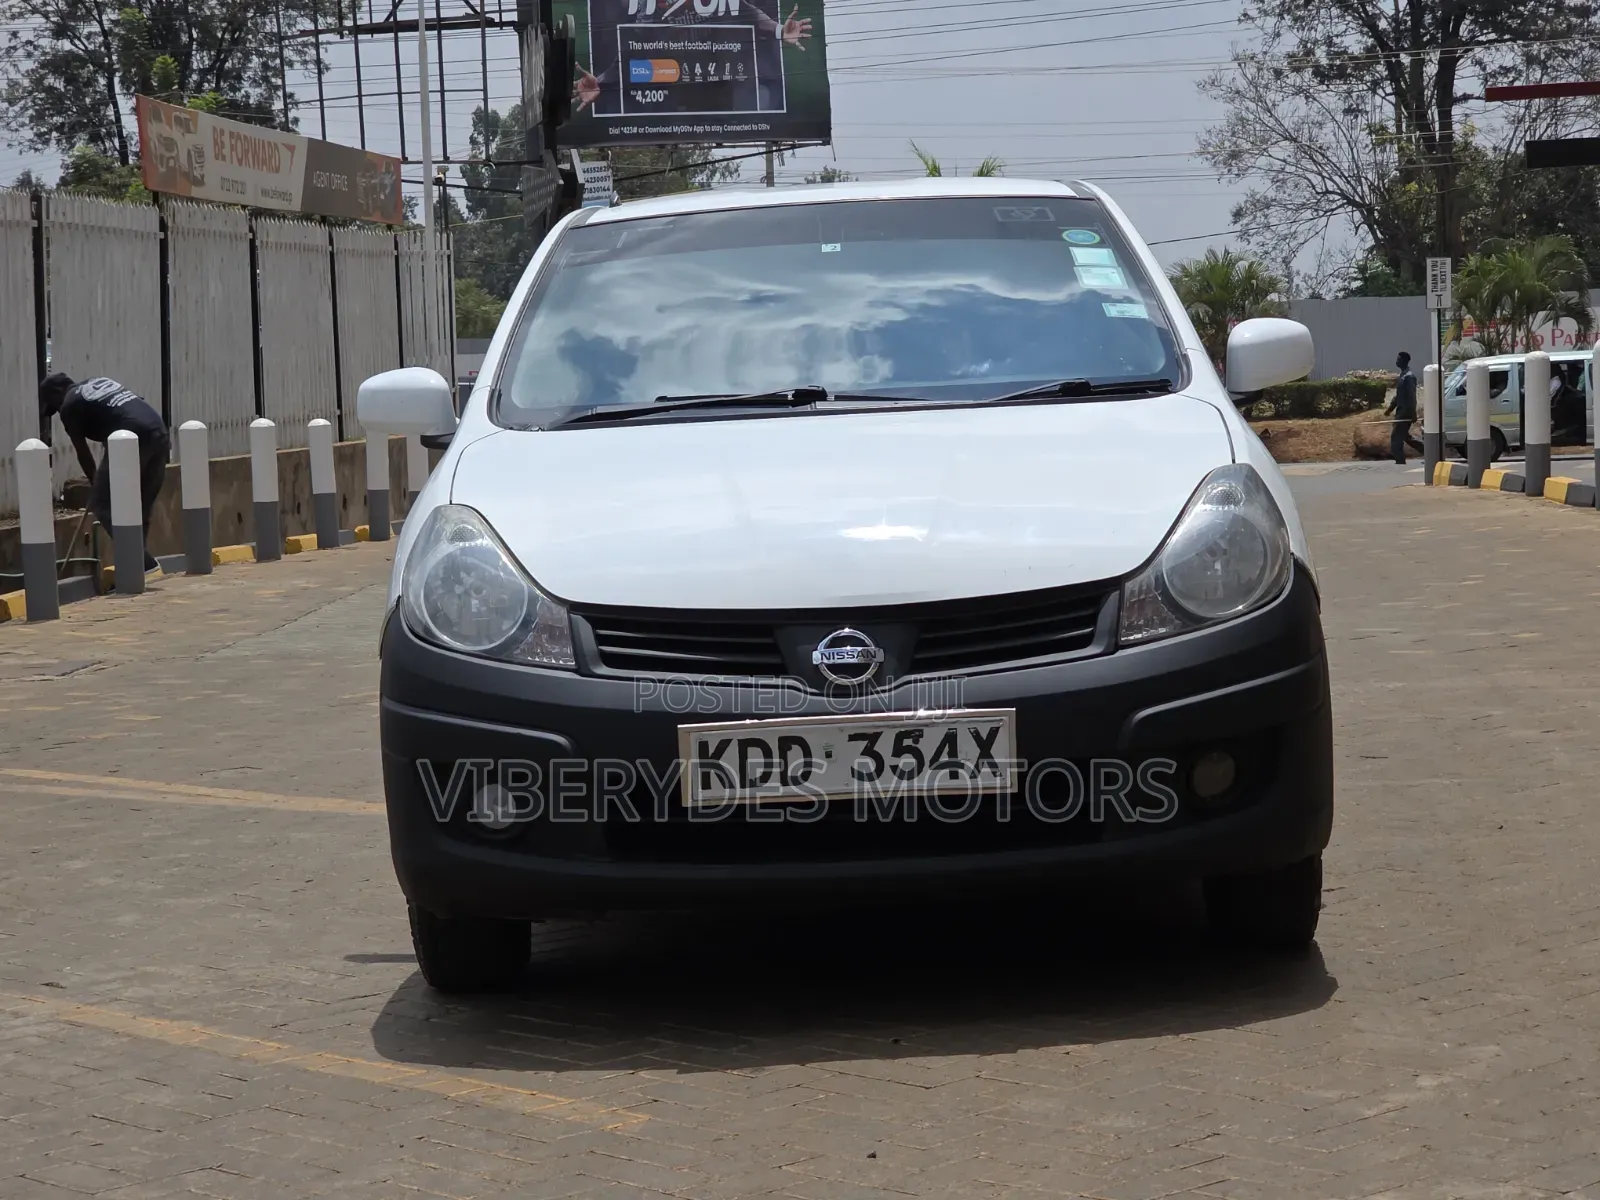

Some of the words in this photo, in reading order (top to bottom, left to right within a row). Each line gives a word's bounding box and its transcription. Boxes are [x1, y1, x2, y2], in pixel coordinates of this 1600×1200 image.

[628, 41, 642, 50] The
[643, 41, 668, 50] world's
[669, 41, 685, 50] best
[685, 41, 712, 50] football
[712, 41, 741, 52] package
[636, 90, 664, 104] 4,200
[608, 127, 620, 135] Dial
[645, 126, 672, 134] Download
[693, 125, 704, 134] App
[711, 125, 722, 133] stay
[212, 126, 227, 162] BE
[229, 130, 281, 174] FORWARD
[312, 170, 330, 188] AGENT
[331, 173, 348, 192] OFFICE
[1431, 260, 1439, 273] YOU
[1431, 273, 1439, 293] THANK
[1440, 270, 1448, 284] NEXT
[820, 650, 877, 661] NISSAN
[696, 735, 814, 791] KDD
[846, 725, 1005, 783] 354X
